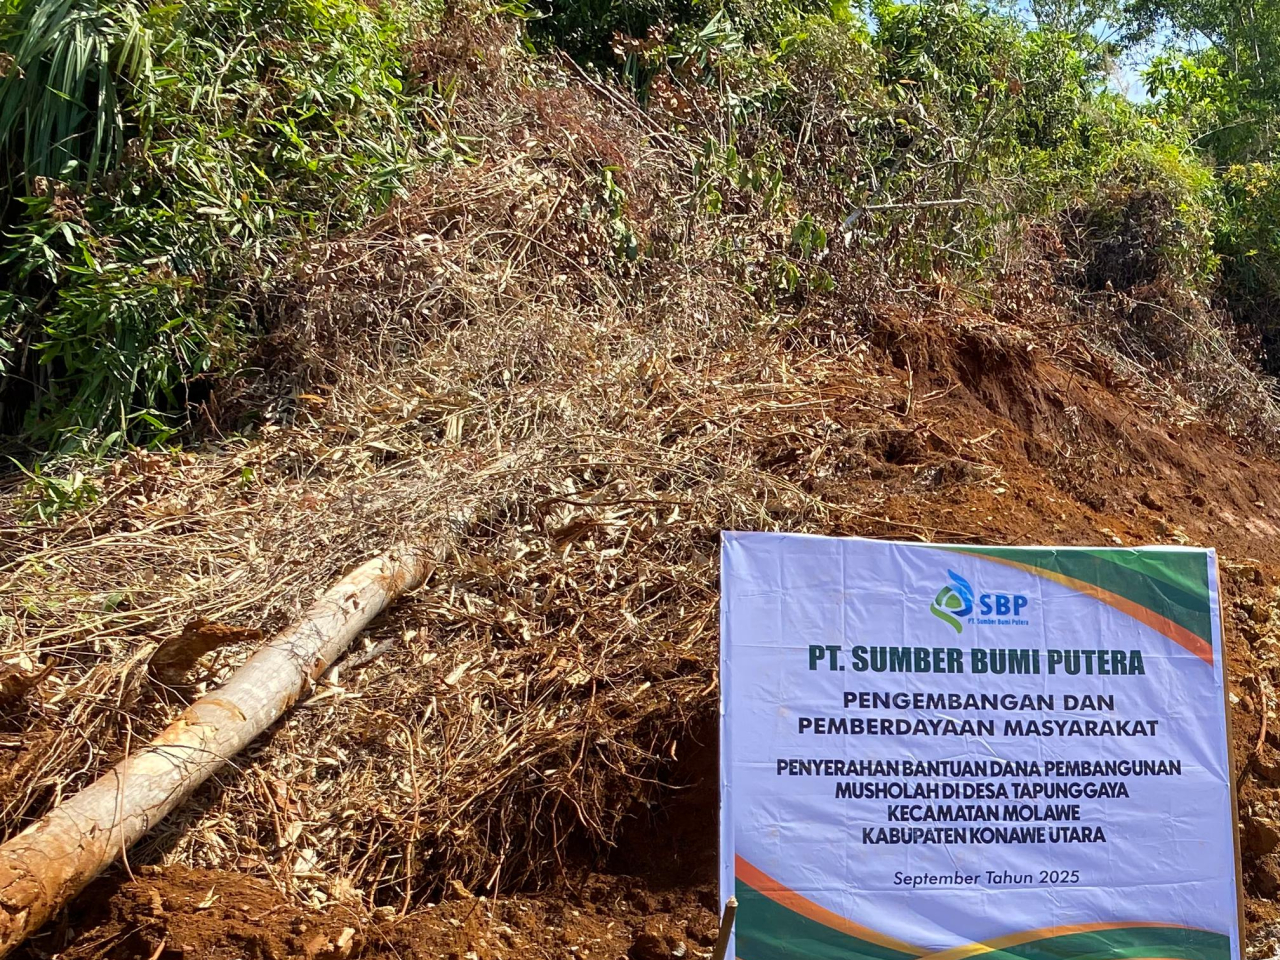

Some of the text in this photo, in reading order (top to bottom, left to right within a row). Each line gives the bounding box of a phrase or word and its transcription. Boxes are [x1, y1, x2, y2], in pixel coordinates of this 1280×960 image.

[980, 595, 1028, 616] SBP
[809, 645, 1145, 675] PT. SUMBER BUMI PUTERA
[843, 691, 1114, 711] PENGEMBANGAN DAN
[799, 717, 1158, 736] PEMBERDAYAAN MASYARAKAT
[777, 759, 1181, 777] PENYERAHAN BANTUAN DANA PEMBANGUNAN
[835, 781, 1129, 799] MUSHOLAH DI DESA TAPUNGGAYA
[887, 804, 1080, 822] KECAMATAN MOLAWE
[863, 826, 1106, 844] KABUPATEN KONAWE UTARA
[893, 870, 1080, 888] September Tahun 2025
